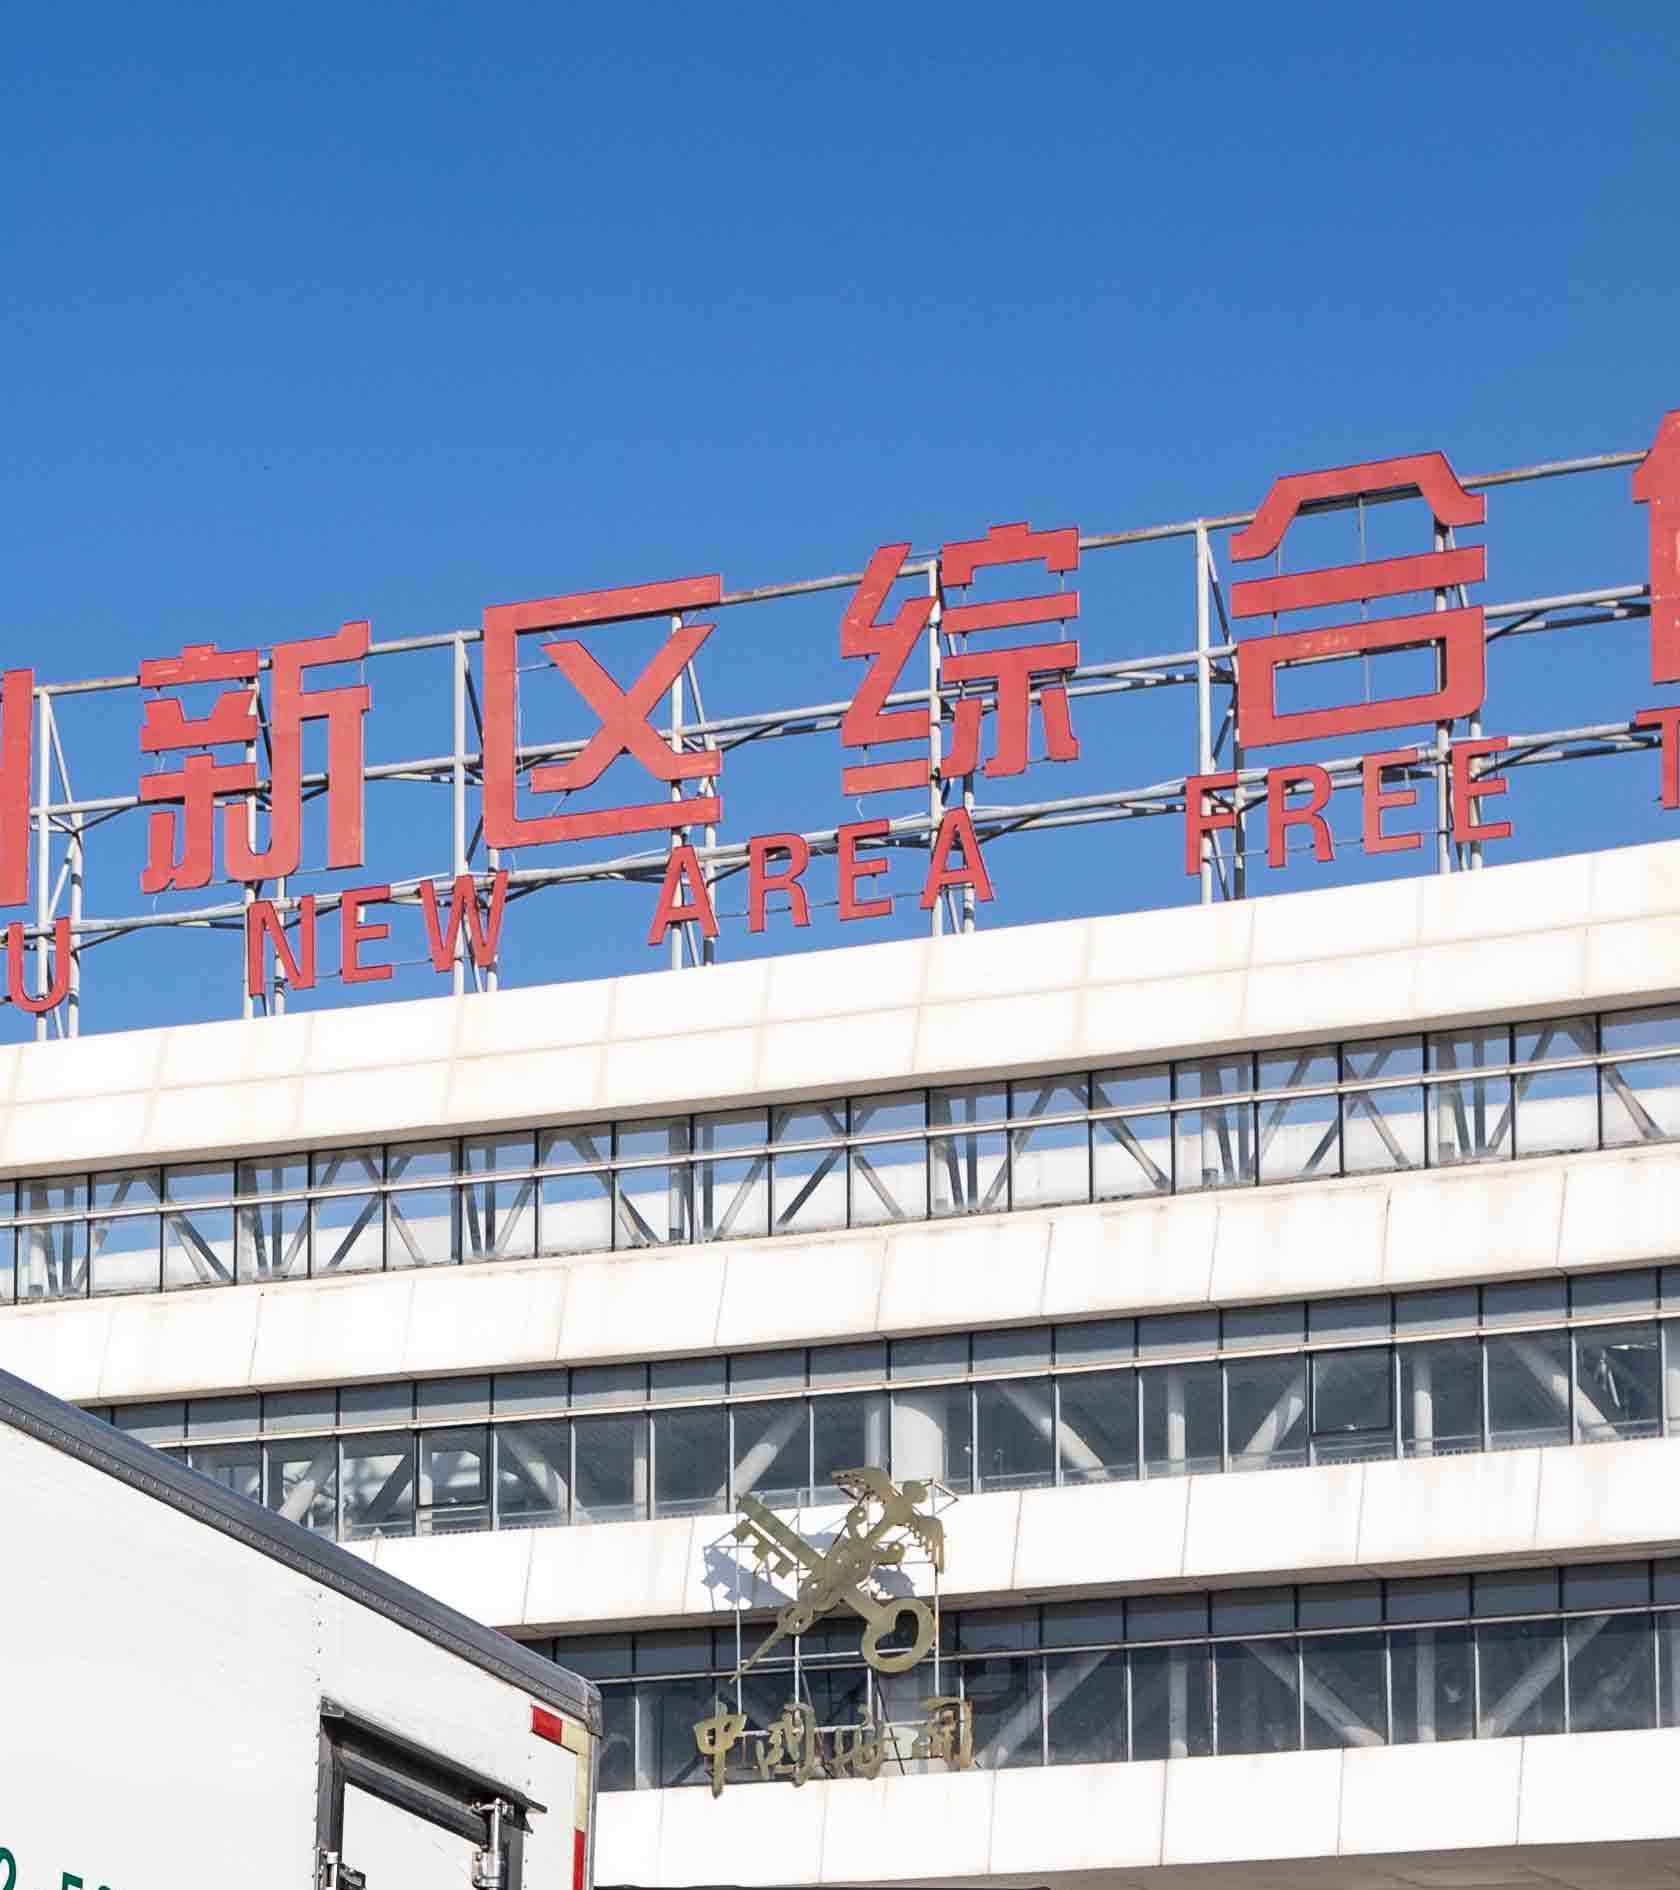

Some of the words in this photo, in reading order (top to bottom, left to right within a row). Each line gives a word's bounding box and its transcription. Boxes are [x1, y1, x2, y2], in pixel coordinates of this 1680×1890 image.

[244, 868, 510, 997] NEW
[647, 806, 995, 947] AREA
[1183, 735, 1515, 876] FREE
